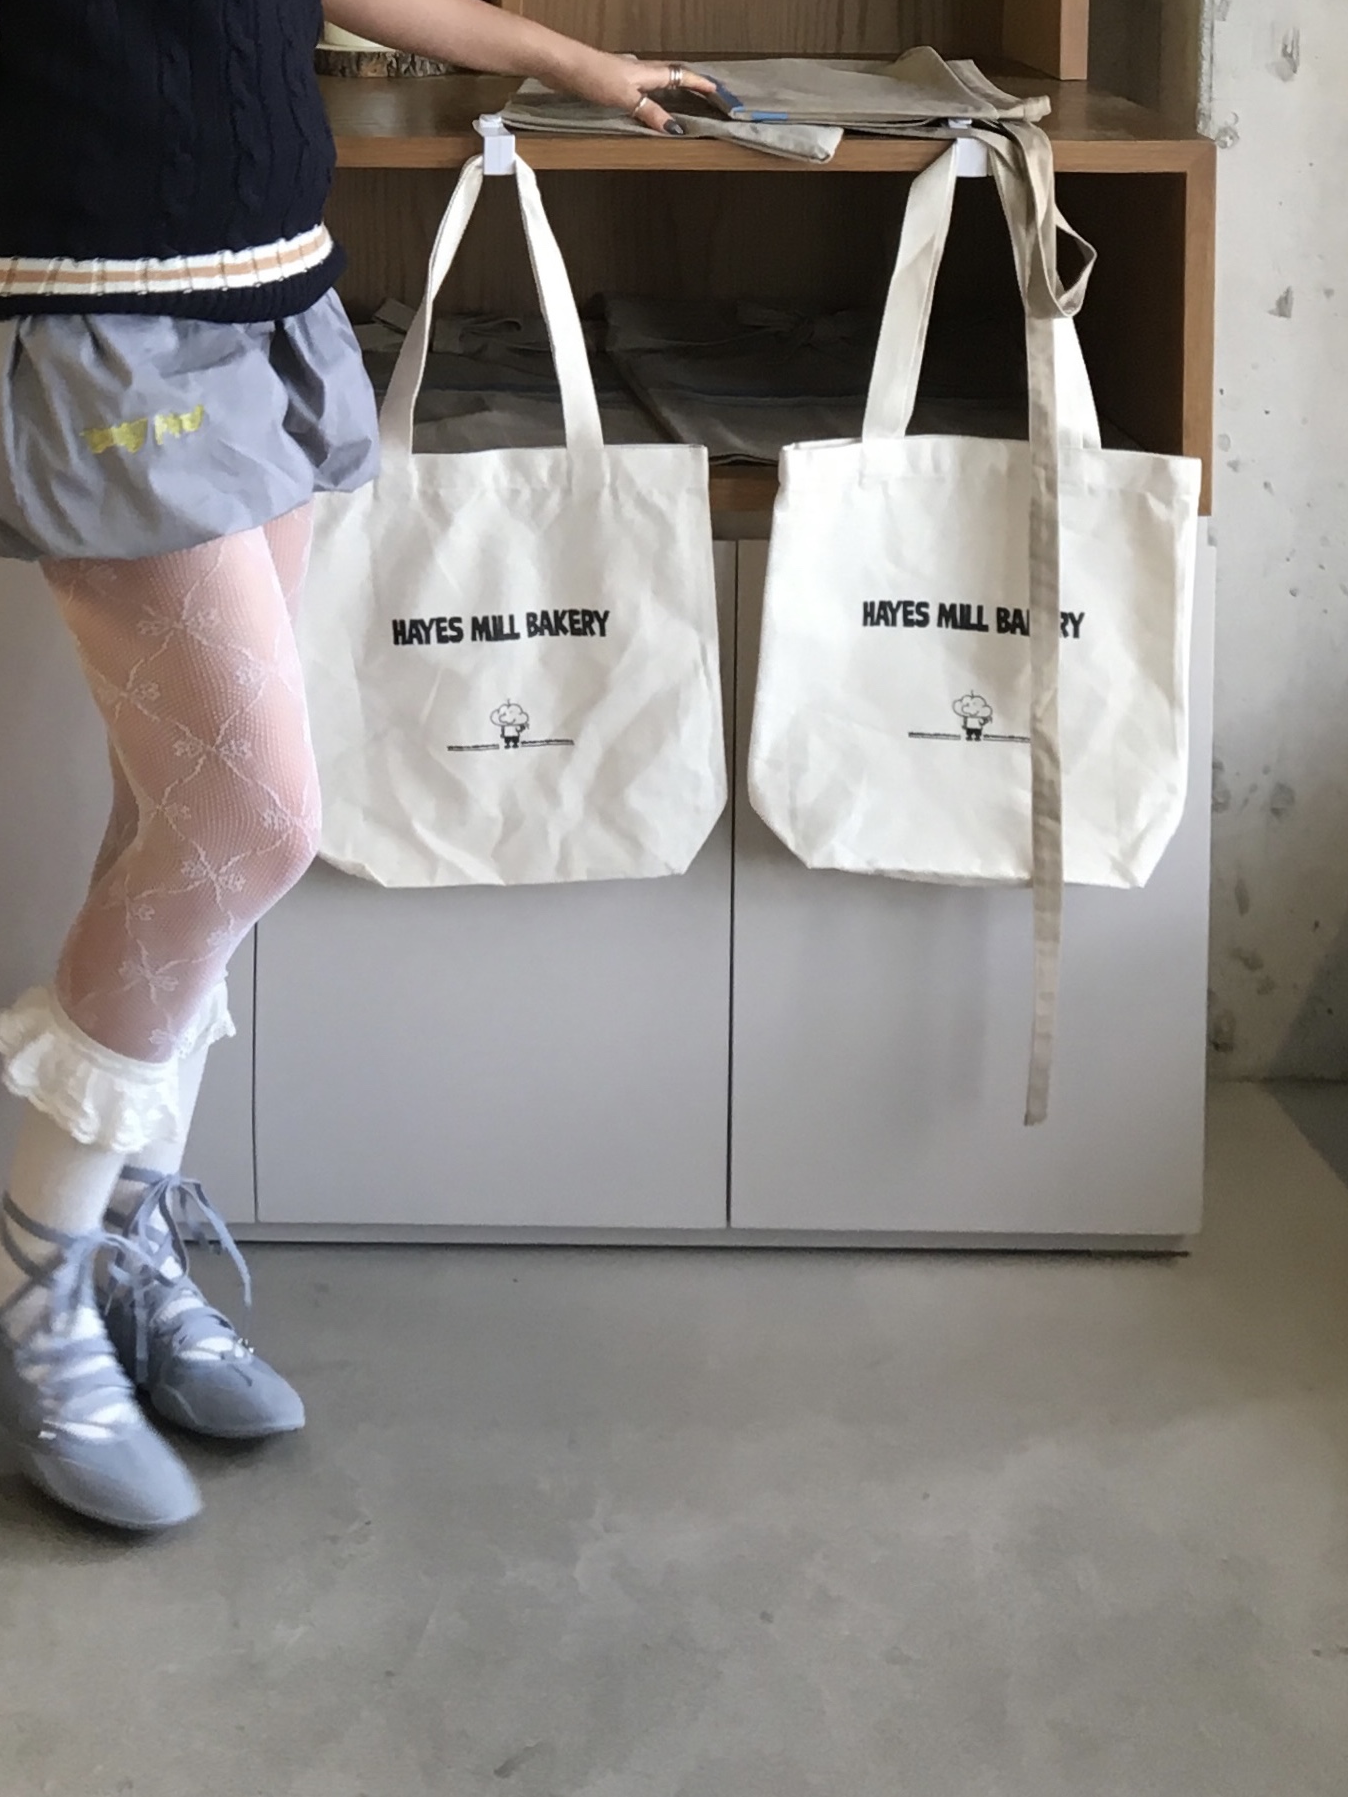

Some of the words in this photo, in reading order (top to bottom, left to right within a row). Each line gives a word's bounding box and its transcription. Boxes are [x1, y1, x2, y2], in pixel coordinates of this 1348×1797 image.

[392, 616, 464, 646] HAYES
[470, 614, 521, 642] MILL
[526, 608, 611, 638] BAKERY
[862, 600, 931, 628] HAYES
[936, 602, 990, 633] MILL
[996, 606, 1086, 639] BARY
